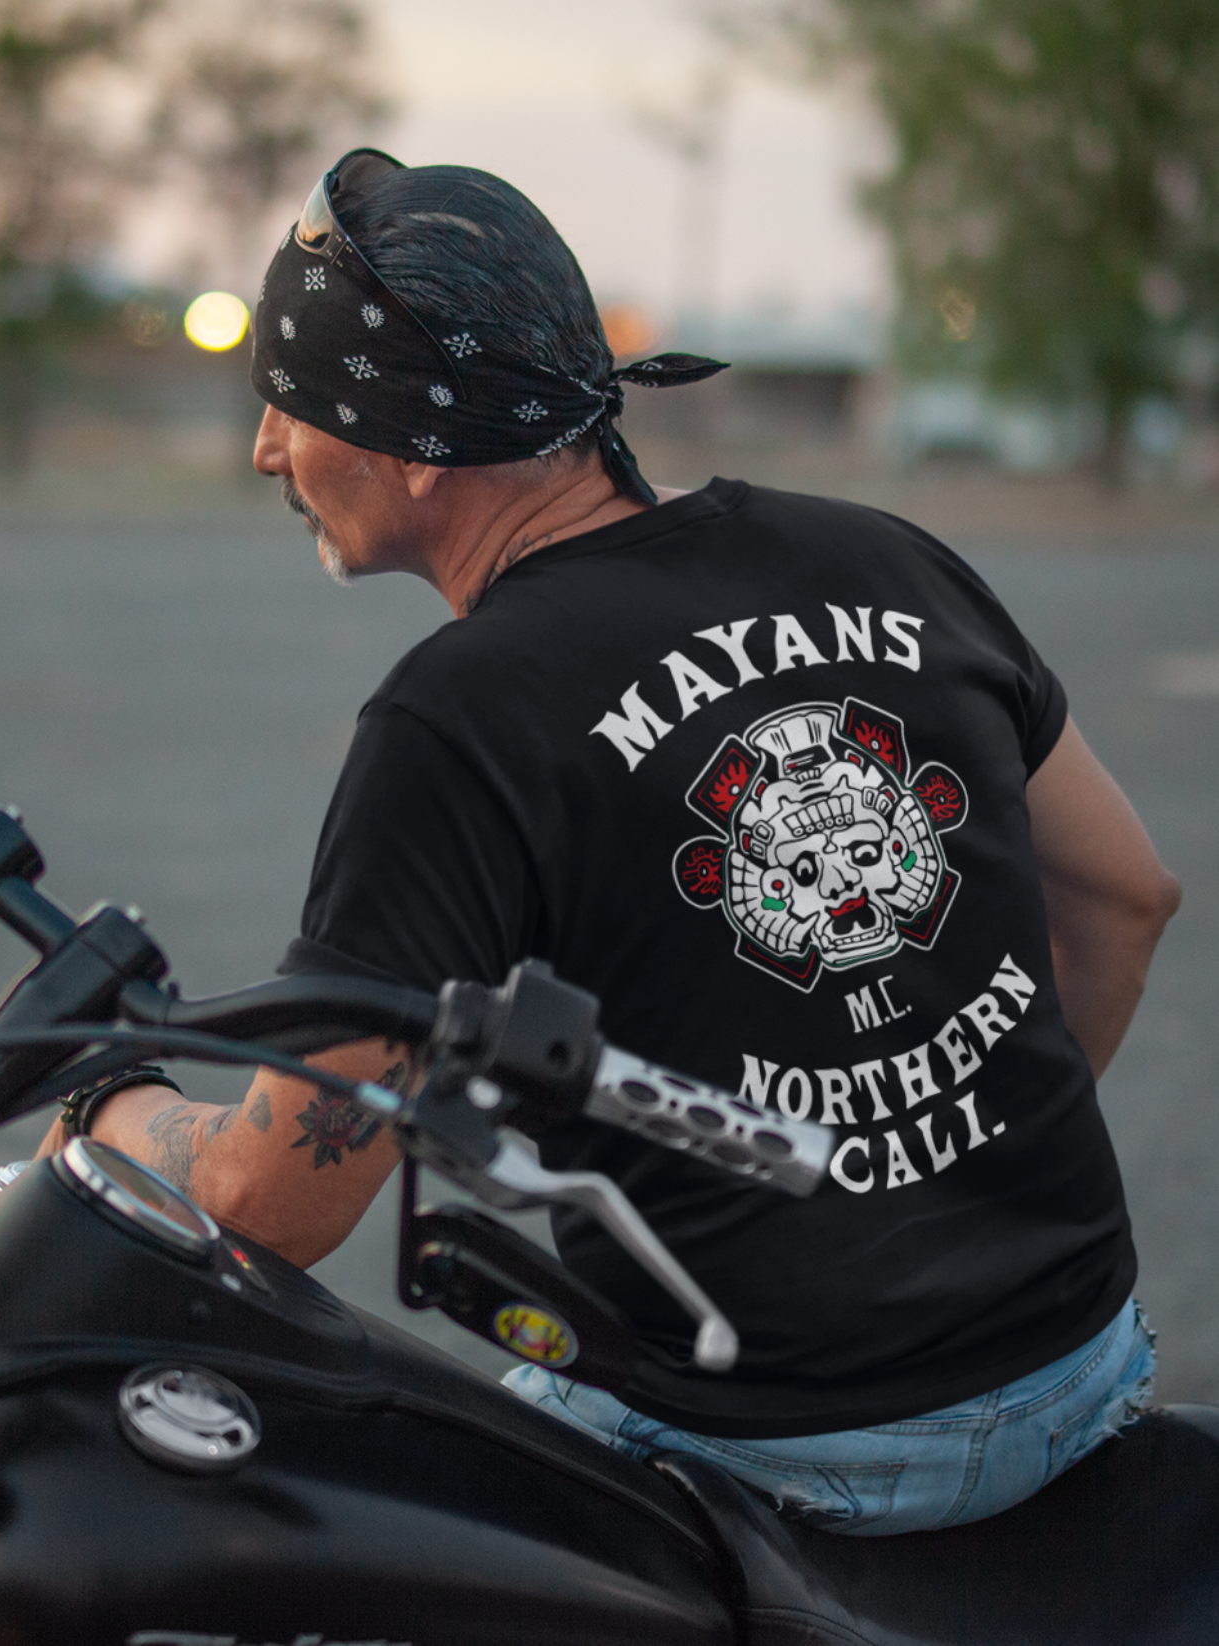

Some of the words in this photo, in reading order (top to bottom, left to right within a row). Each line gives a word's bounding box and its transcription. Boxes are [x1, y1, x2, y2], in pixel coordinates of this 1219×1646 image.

[588, 601, 925, 773] MAYANS
[738, 953, 1037, 1125] NORTHERN
[844, 974, 913, 1034] M.C.
[830, 1090, 1006, 1194] CALI.
